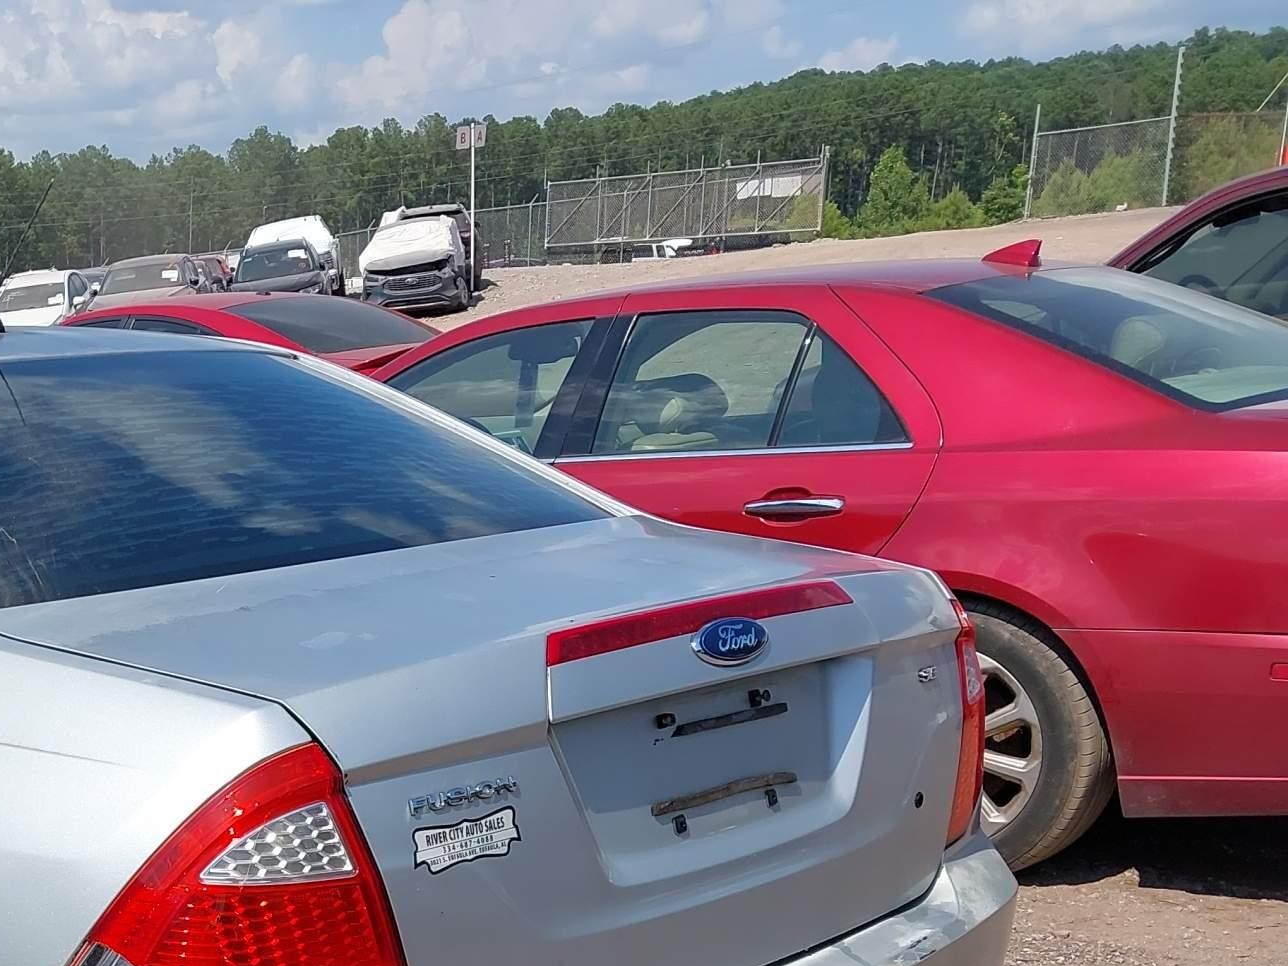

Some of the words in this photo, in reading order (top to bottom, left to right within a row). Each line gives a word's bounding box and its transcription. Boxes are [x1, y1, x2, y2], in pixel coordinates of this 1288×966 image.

[460, 132, 466, 144] B
[476, 130, 483, 143] A
[718, 623, 758, 652] Ford
[918, 666, 937, 683] SE
[407, 775, 518, 817] FUSION
[425, 830, 448, 847] RIVER
[448, 825, 465, 843] CITY
[465, 822, 484, 840] AUTO
[484, 816, 505, 833] SALES
